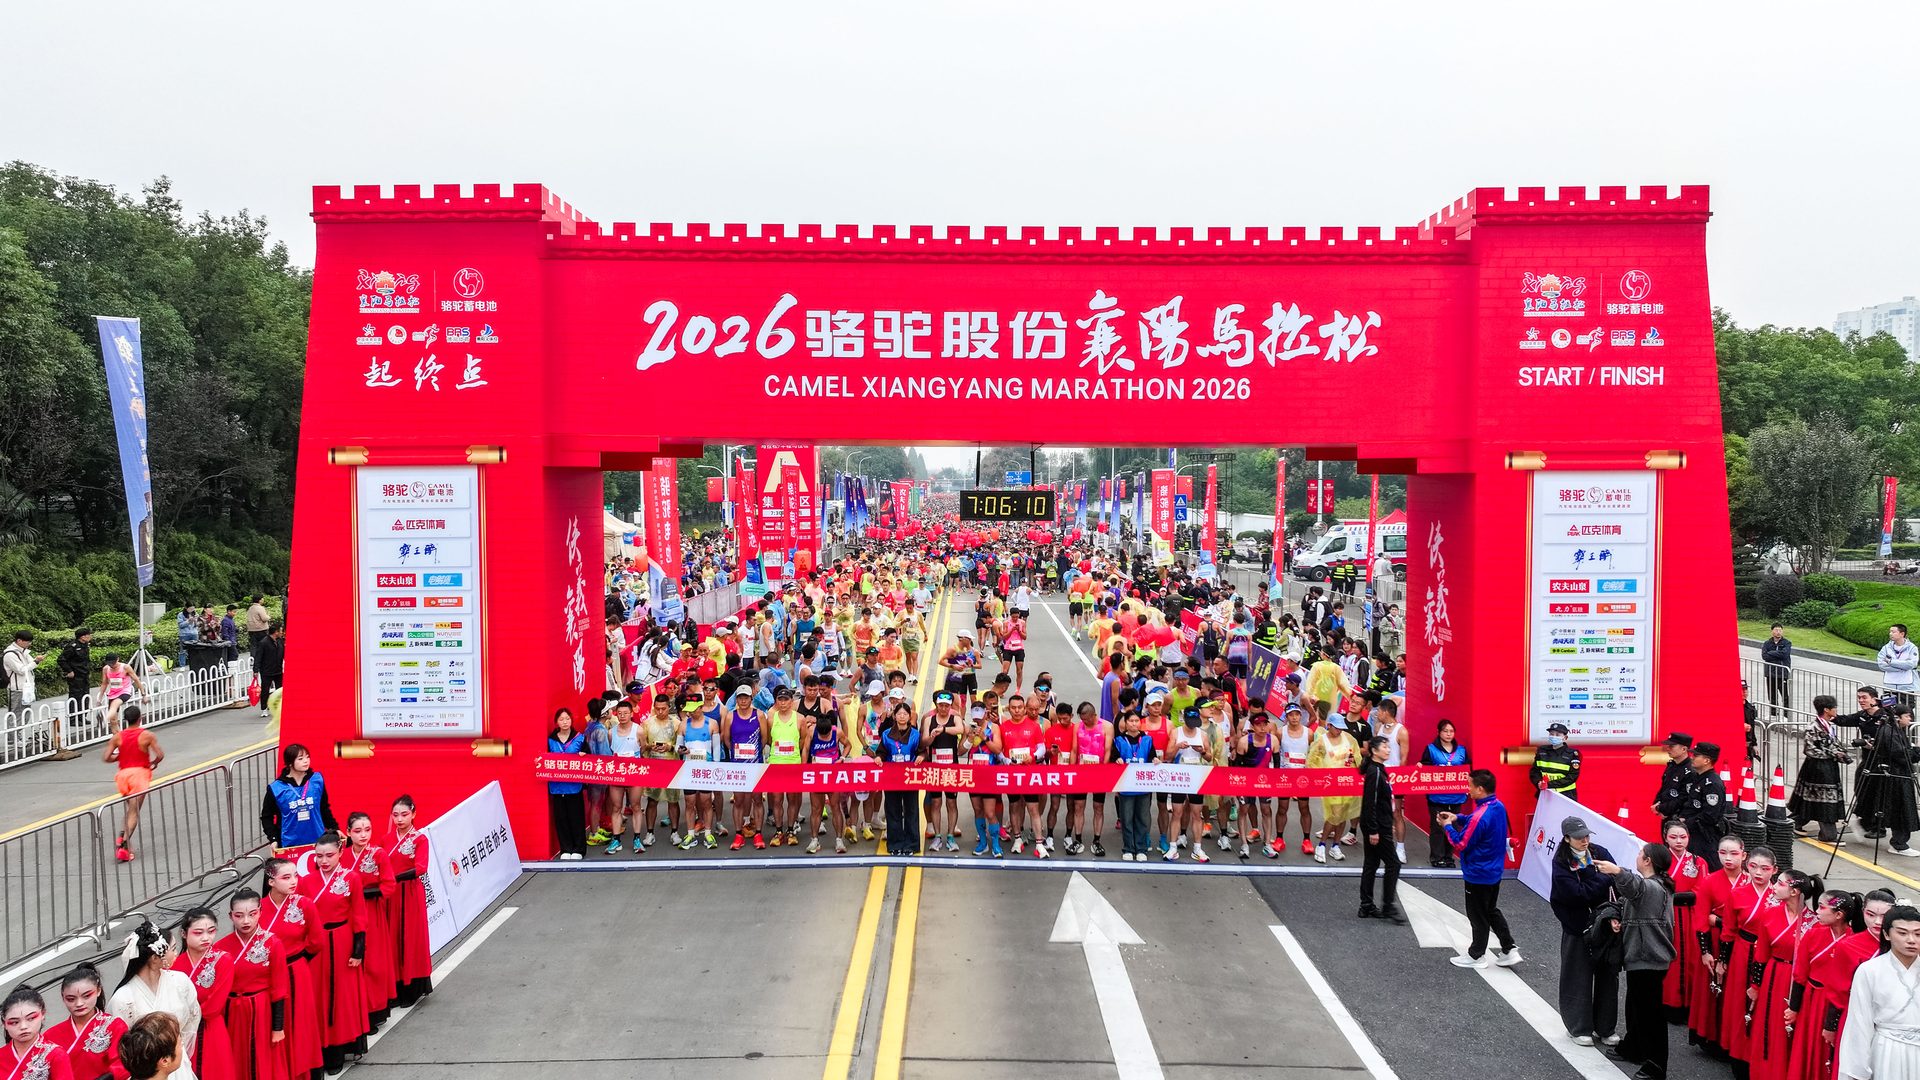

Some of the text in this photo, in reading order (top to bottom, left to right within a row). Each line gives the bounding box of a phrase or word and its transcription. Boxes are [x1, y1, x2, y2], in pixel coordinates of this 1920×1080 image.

[441, 300, 497, 312] 骆驼蓄电池
[1607, 303, 1663, 314] 骆驼蓄电池
[636, 293, 798, 370] 2026
[806, 310, 1067, 359] 骆驼股份
[363, 354, 488, 391] 起终点
[1519, 367, 1584, 386] START
[1601, 366, 1664, 385] FINISH
[765, 374, 1250, 400] CAMEL XIANGYANG MARATHON 2026
[383, 484, 408, 496] 骆驼
[1560, 489, 1585, 501] 骆驼
[763, 496, 810, 507] 集区
[967, 496, 1046, 516] 7:06:10
[406, 520, 445, 529] 匹克体育
[1582, 525, 1621, 535] 匹克体育
[380, 577, 414, 585] 农夫山泉
[1552, 582, 1587, 591] 农夫山泉
[544, 759, 593, 771] 骆驼股份
[692, 769, 711, 779] 骆驼
[803, 770, 883, 784] START
[996, 772, 1077, 786] START
[1388, 770, 1418, 785] 2026
[461, 825, 508, 873] 中国田径协会
